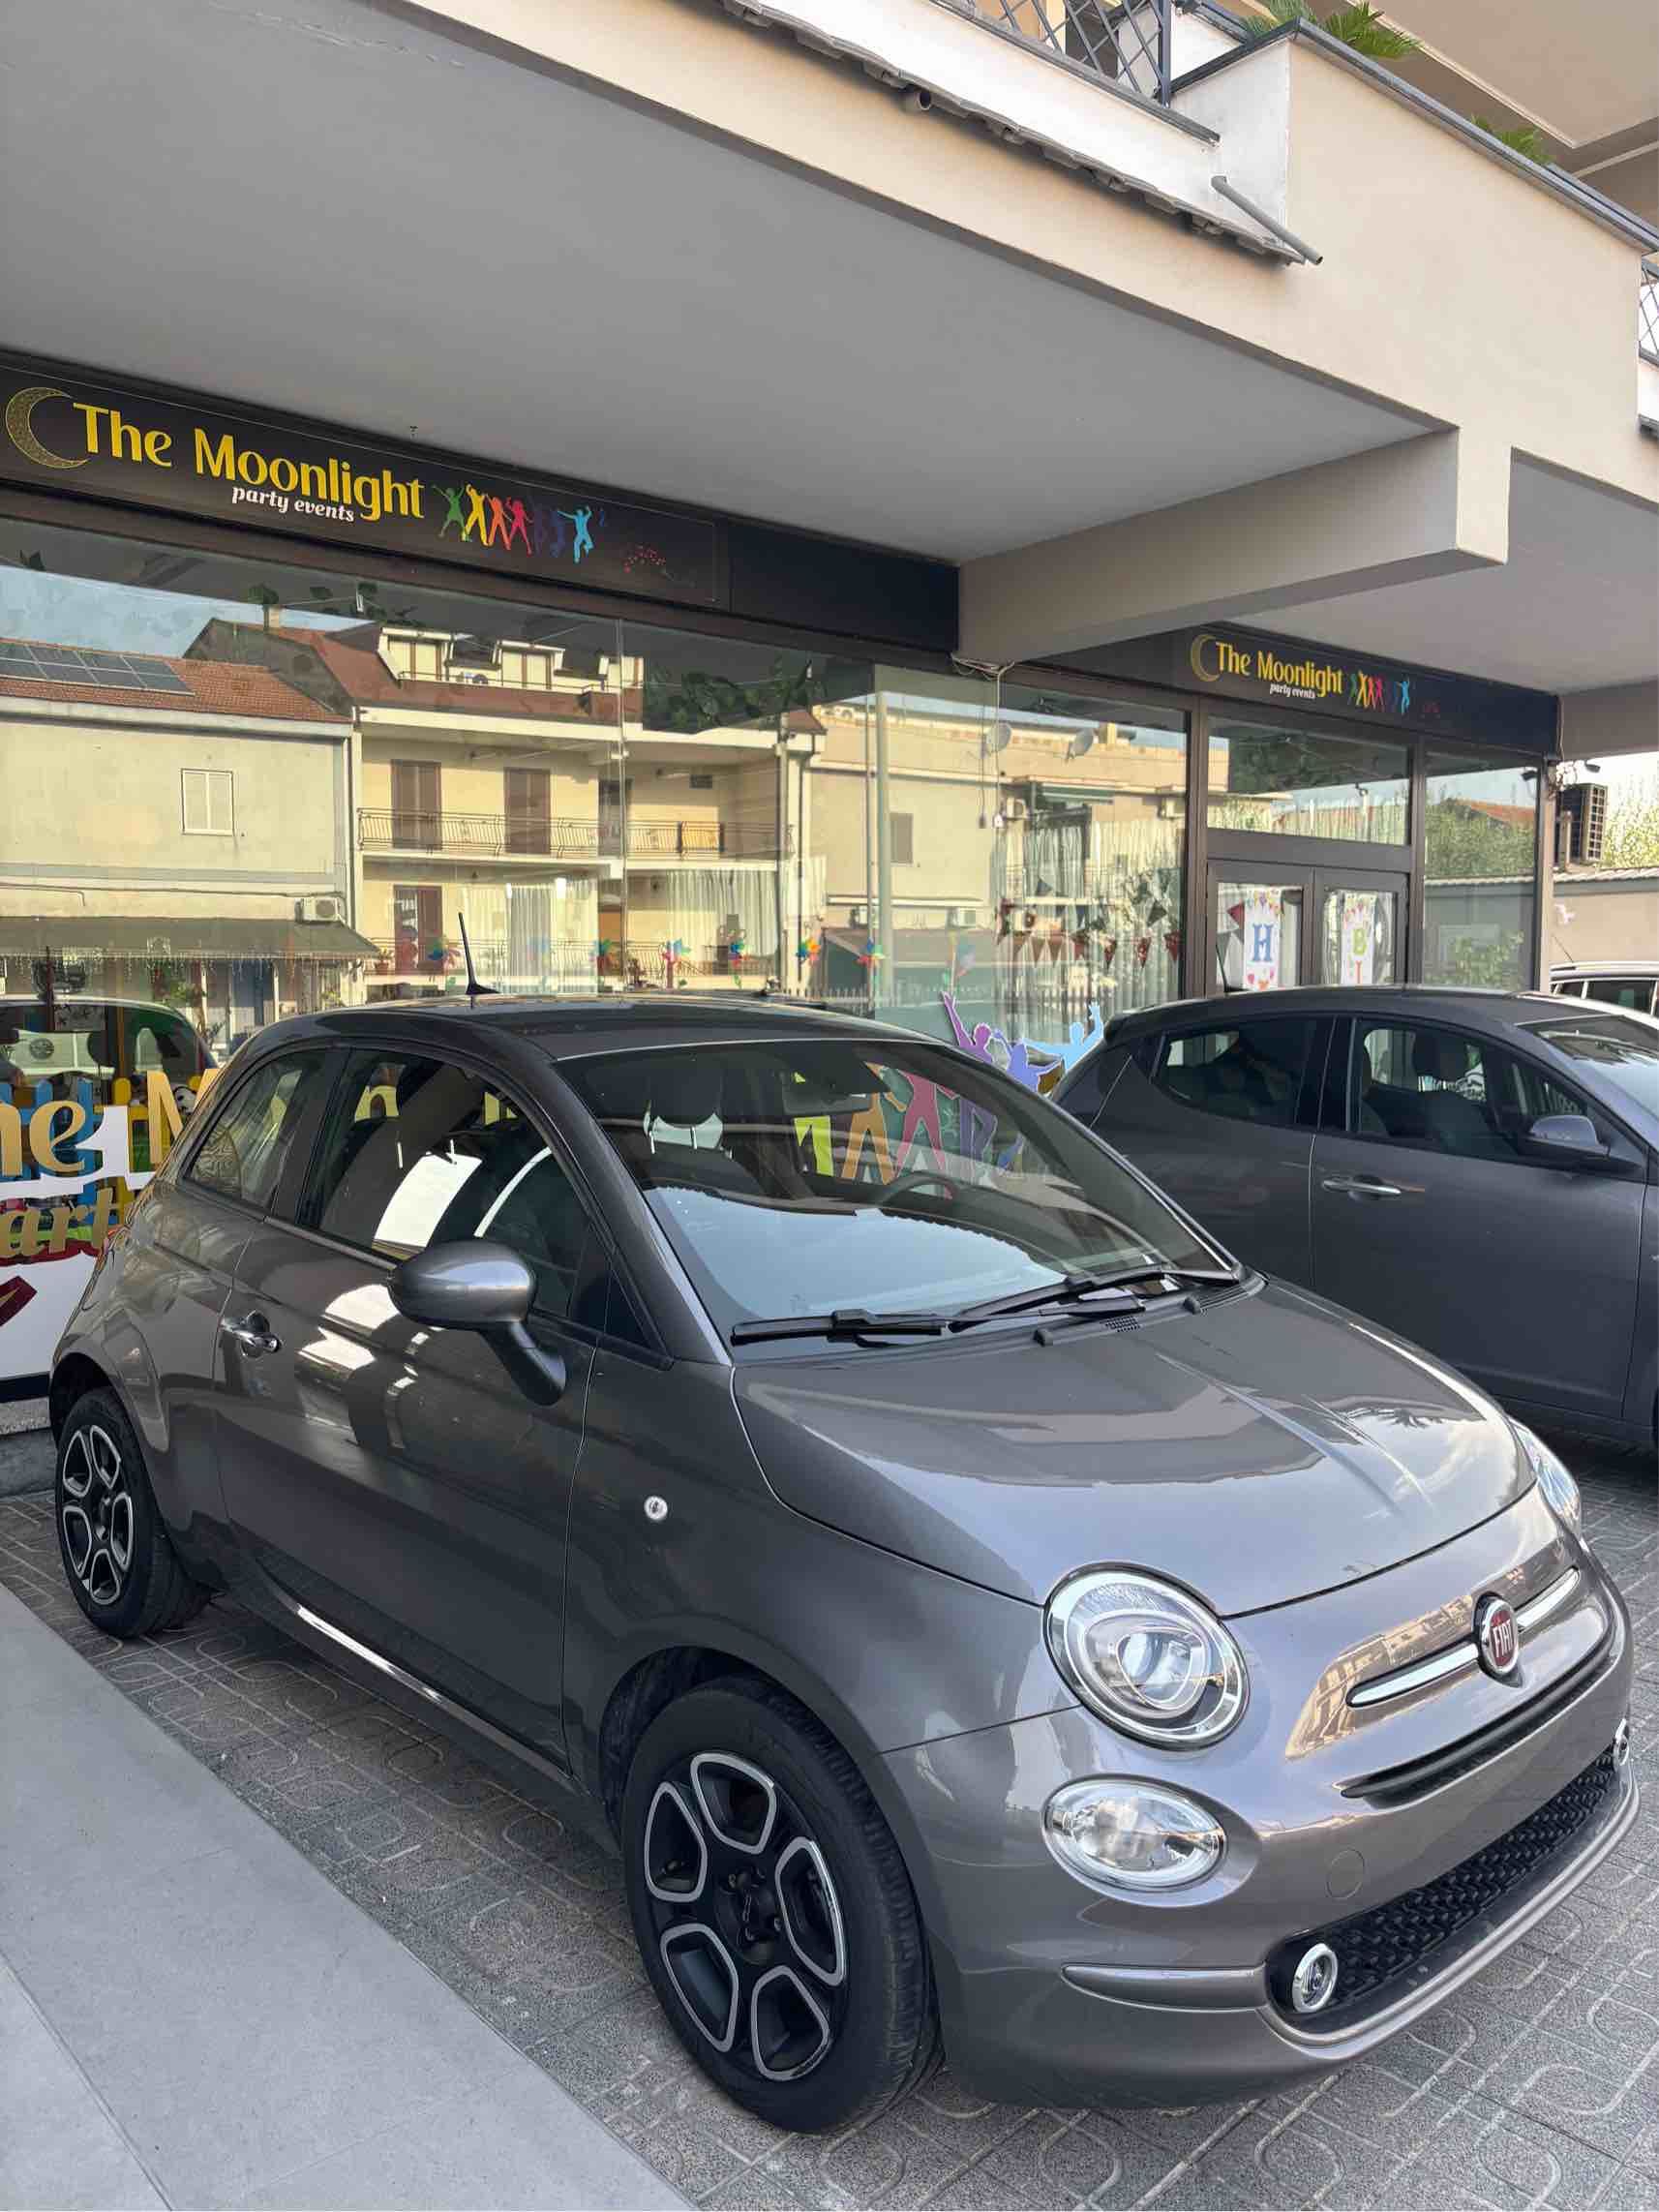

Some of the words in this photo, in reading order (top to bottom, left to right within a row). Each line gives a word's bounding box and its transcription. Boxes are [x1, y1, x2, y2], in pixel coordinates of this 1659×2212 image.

[73, 402, 172, 468] The
[194, 427, 425, 522] Moonlight
[231, 486, 289, 514] party
[293, 498, 355, 523] events
[1215, 641, 1252, 677] The
[1257, 650, 1343, 698] Moonlight
[1269, 682, 1291, 698] party
[1291, 688, 1316, 700] events
[1492, 1619, 1514, 1658] FIAT
